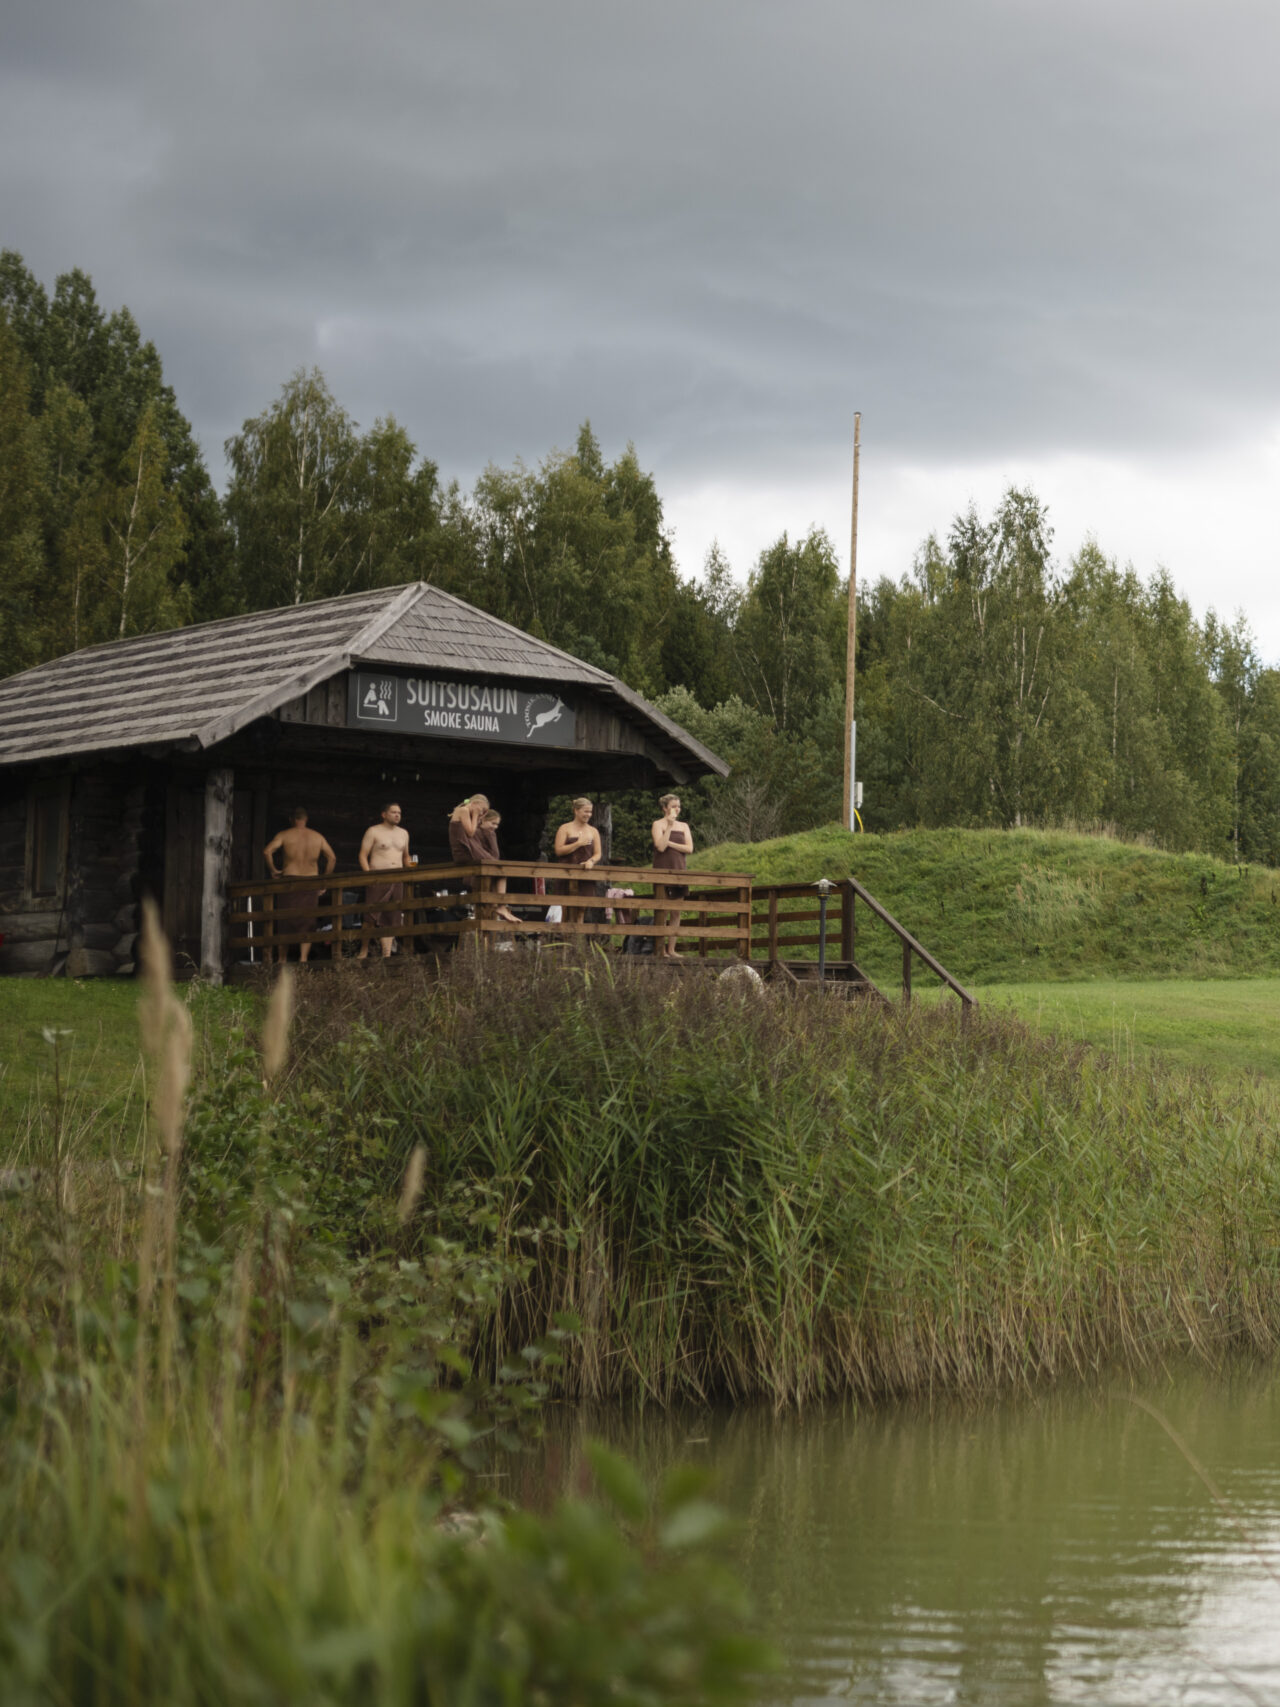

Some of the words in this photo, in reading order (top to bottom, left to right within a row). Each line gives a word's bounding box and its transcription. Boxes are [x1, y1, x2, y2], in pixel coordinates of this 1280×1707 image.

[407, 678, 518, 715] SUITSUSAUN
[424, 710, 462, 728] SMOKE
[464, 714, 500, 733] SAUNA
